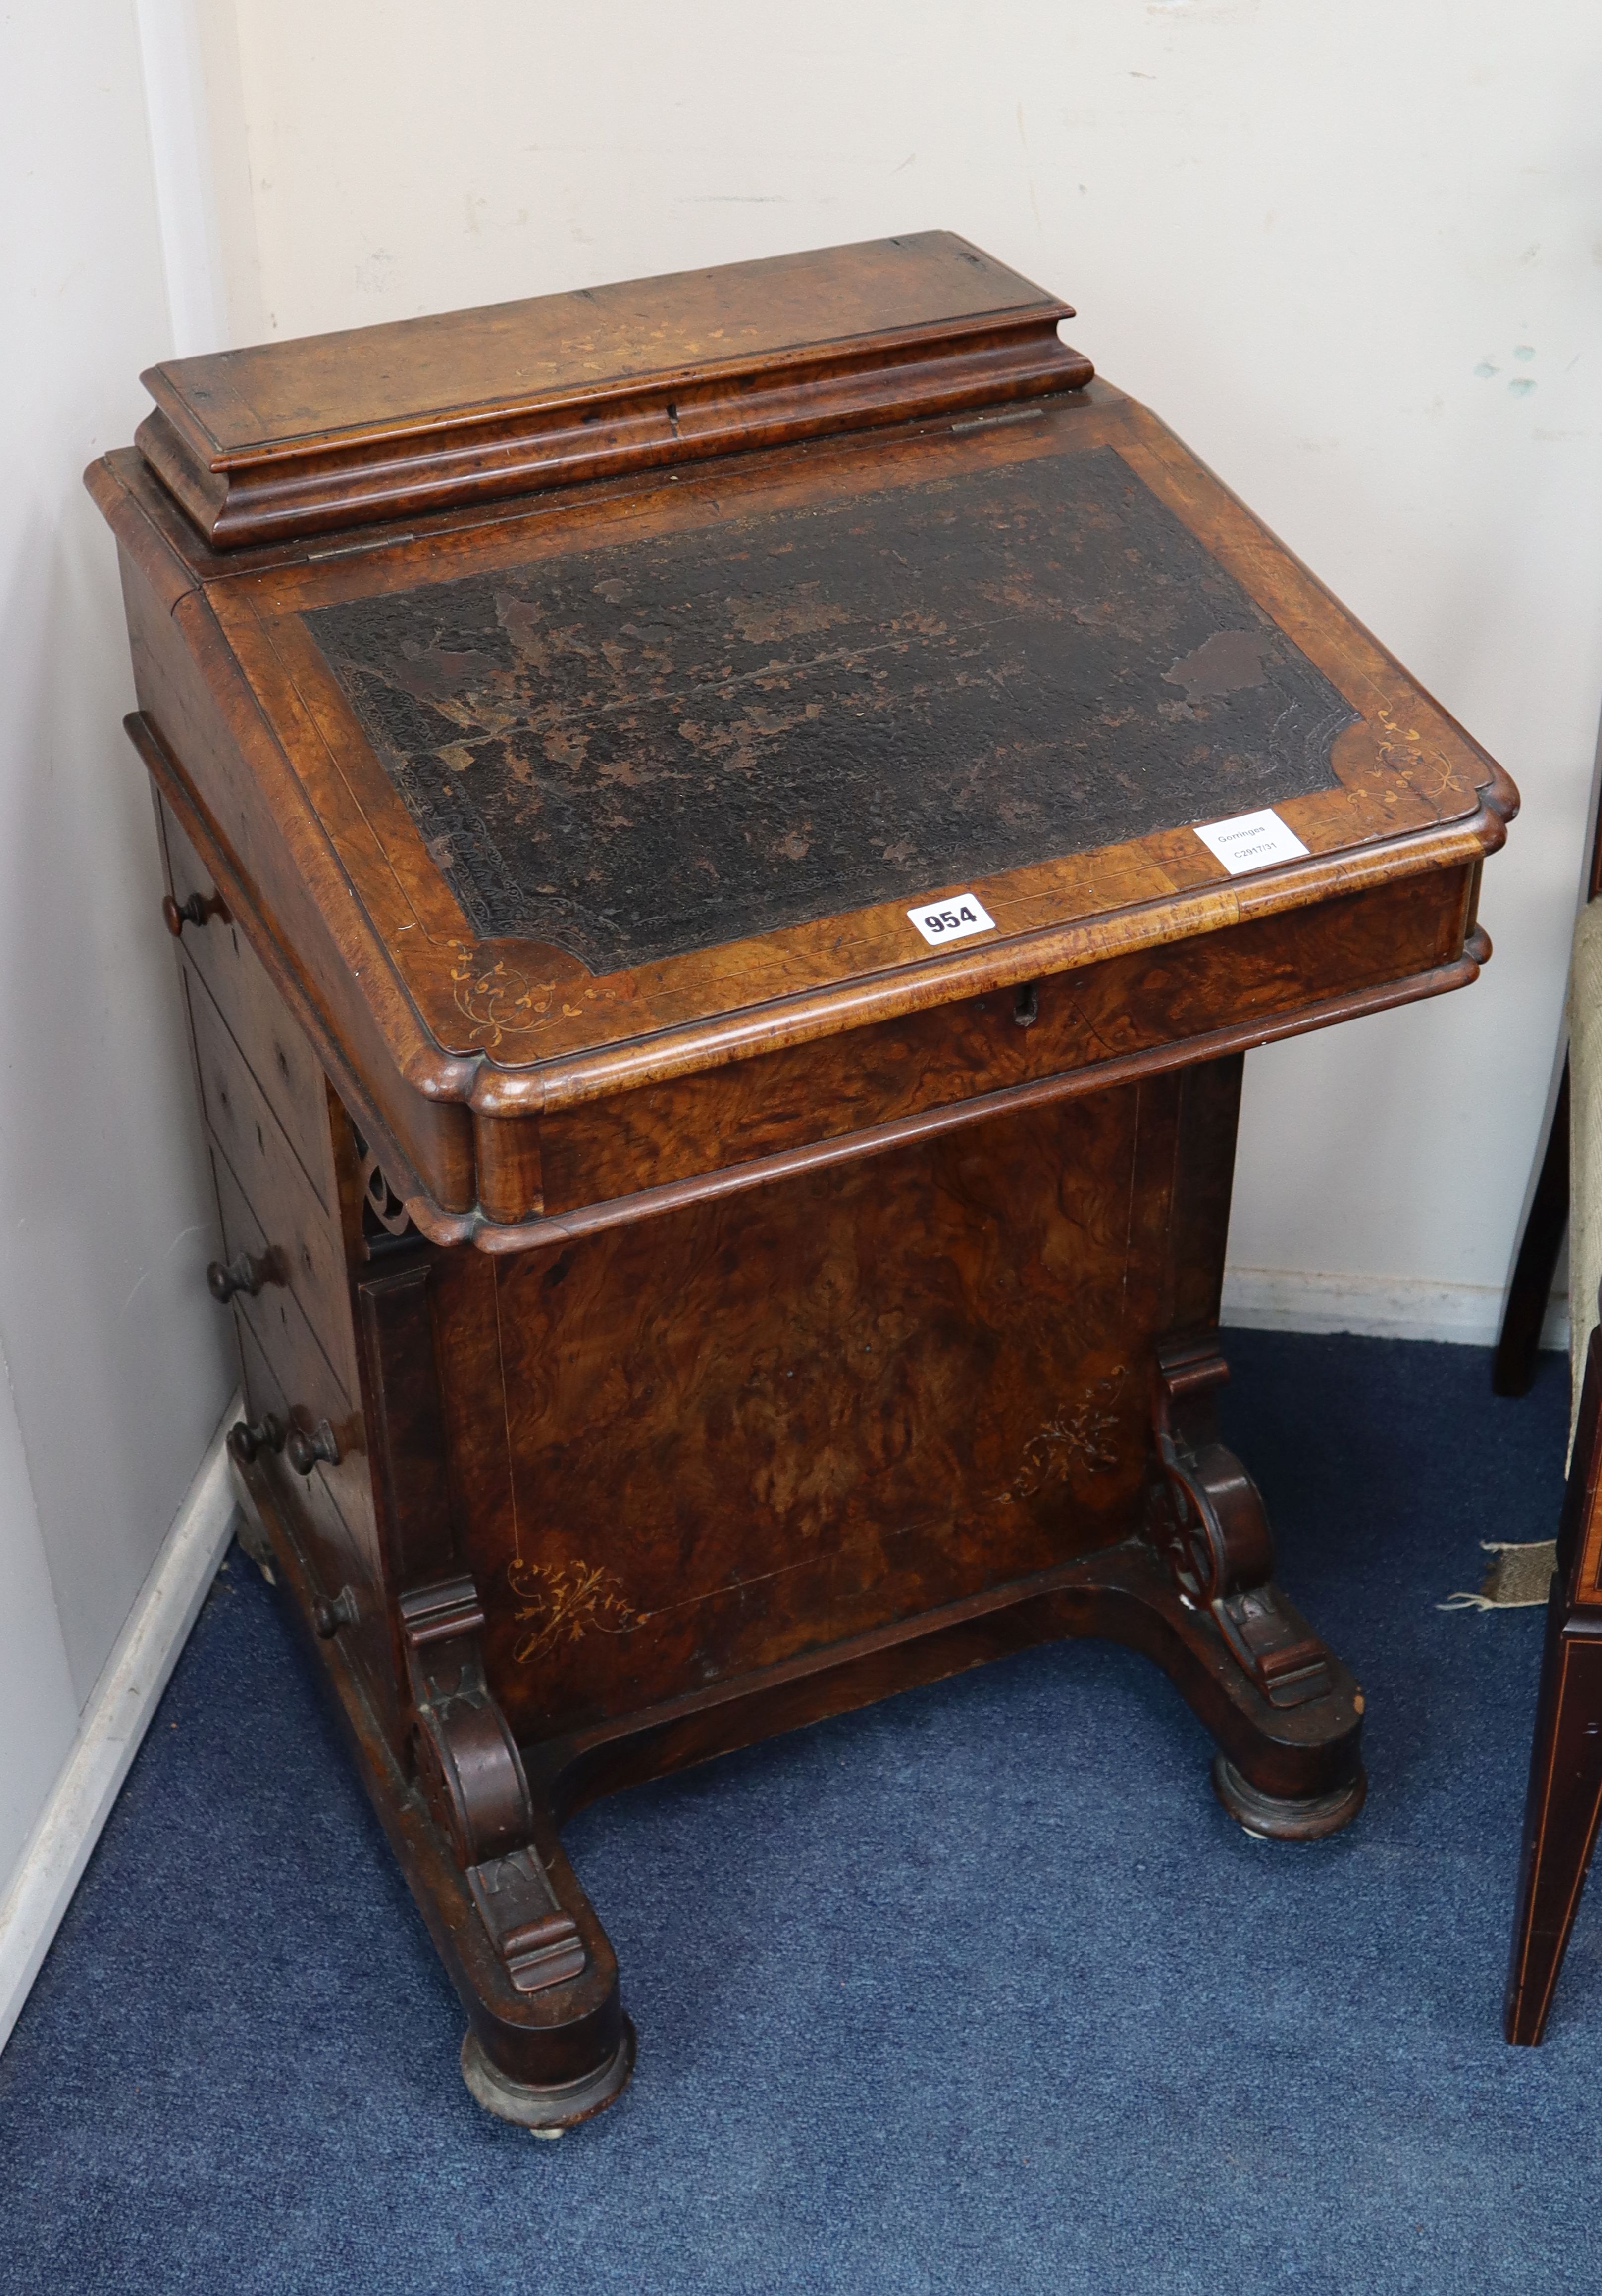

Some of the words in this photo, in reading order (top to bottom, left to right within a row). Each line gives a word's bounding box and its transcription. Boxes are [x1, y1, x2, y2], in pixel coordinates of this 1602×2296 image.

[1218, 826, 1265, 843] Gorringes
[1234, 842, 1277, 858] C2917/31
[925, 907, 977, 933] 954
